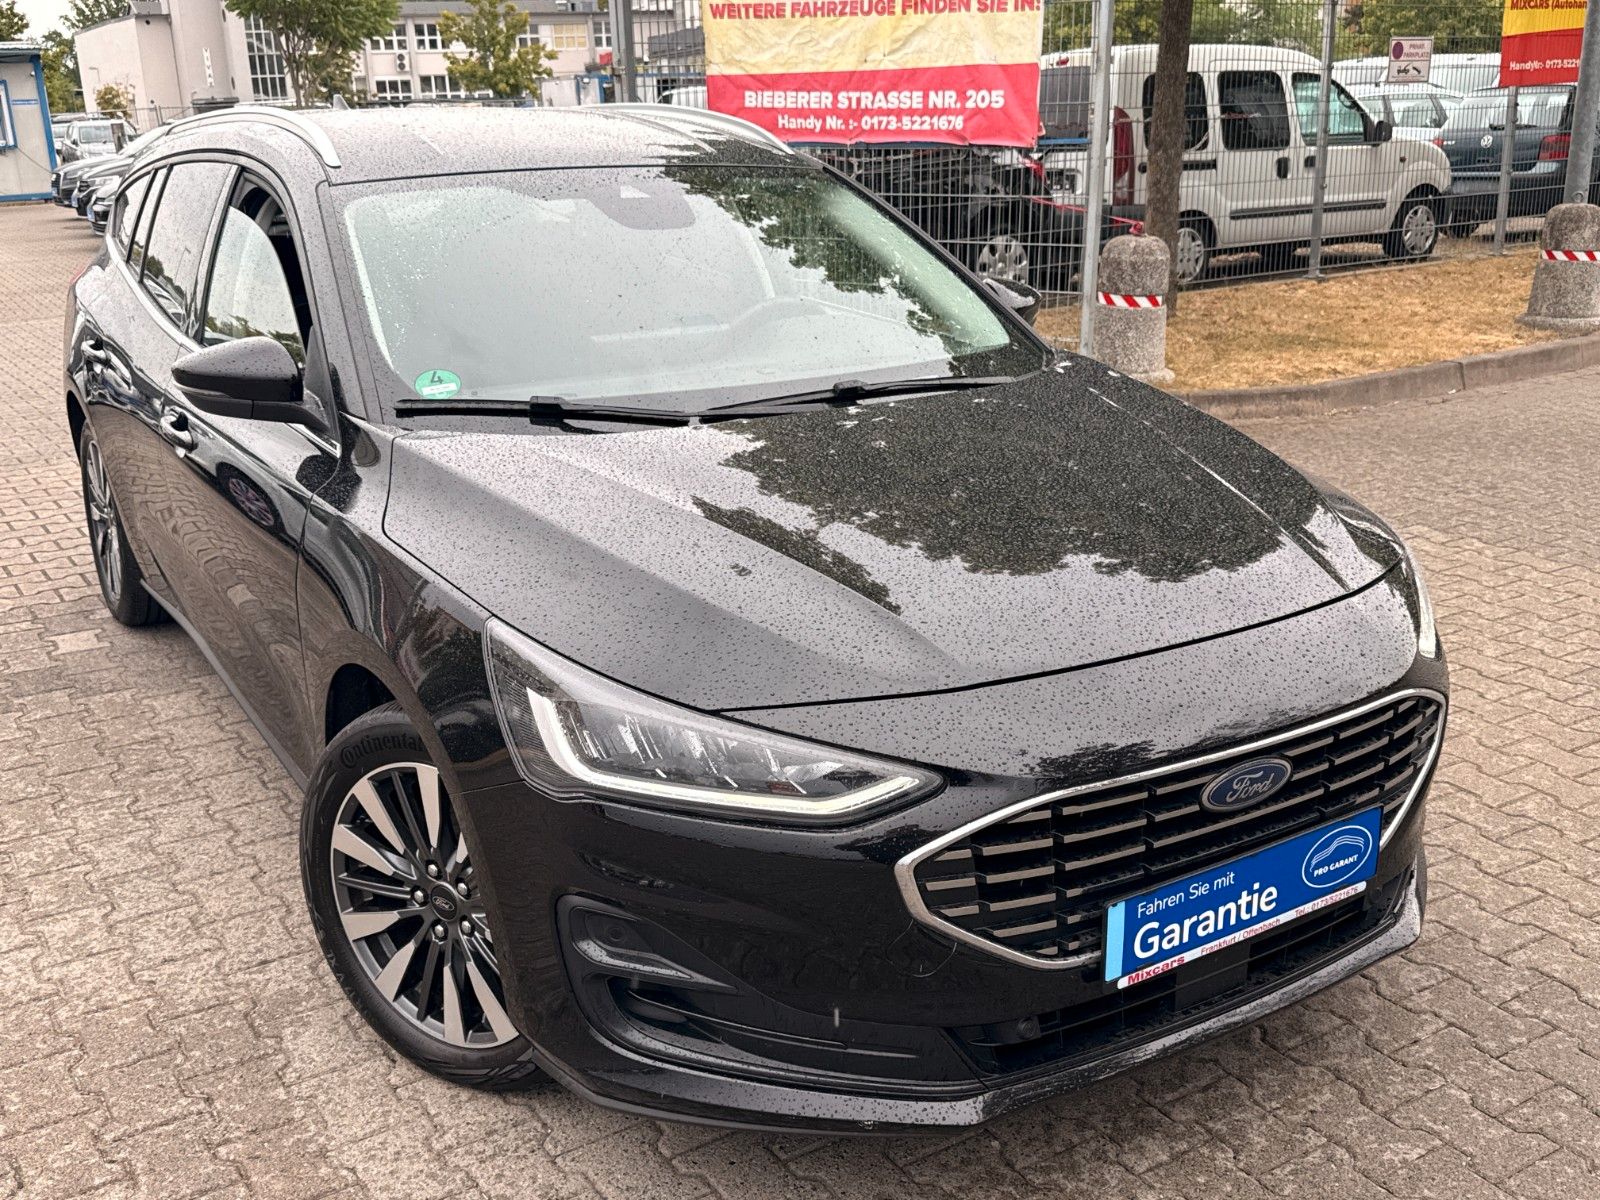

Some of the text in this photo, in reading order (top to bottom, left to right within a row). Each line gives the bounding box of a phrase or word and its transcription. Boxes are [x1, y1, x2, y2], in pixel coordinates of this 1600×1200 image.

[709, 0, 1041, 19] WEITERE FAHRZEUGE FINDEN SIE IN:
[1510, 0, 1550, 11] MIXCARS
[744, 89, 1005, 110] BIEBERER STRASSE NR. 205
[777, 114, 823, 133] Handy
[825, 115, 845, 130] Nr.
[861, 115, 964, 130] 0173-5221676
[430, 371, 443, 384] 4
[1226, 770, 1275, 802] Ford
[1313, 854, 1359, 877] PRO GARANT
[1137, 871, 1236, 918] Fahren Sie mit
[1133, 882, 1278, 959] Garantie
[1127, 956, 1185, 985] Mixcars
[1201, 935, 1237, 955] Frankfurt
[1243, 918, 1281, 938] Offenbach
